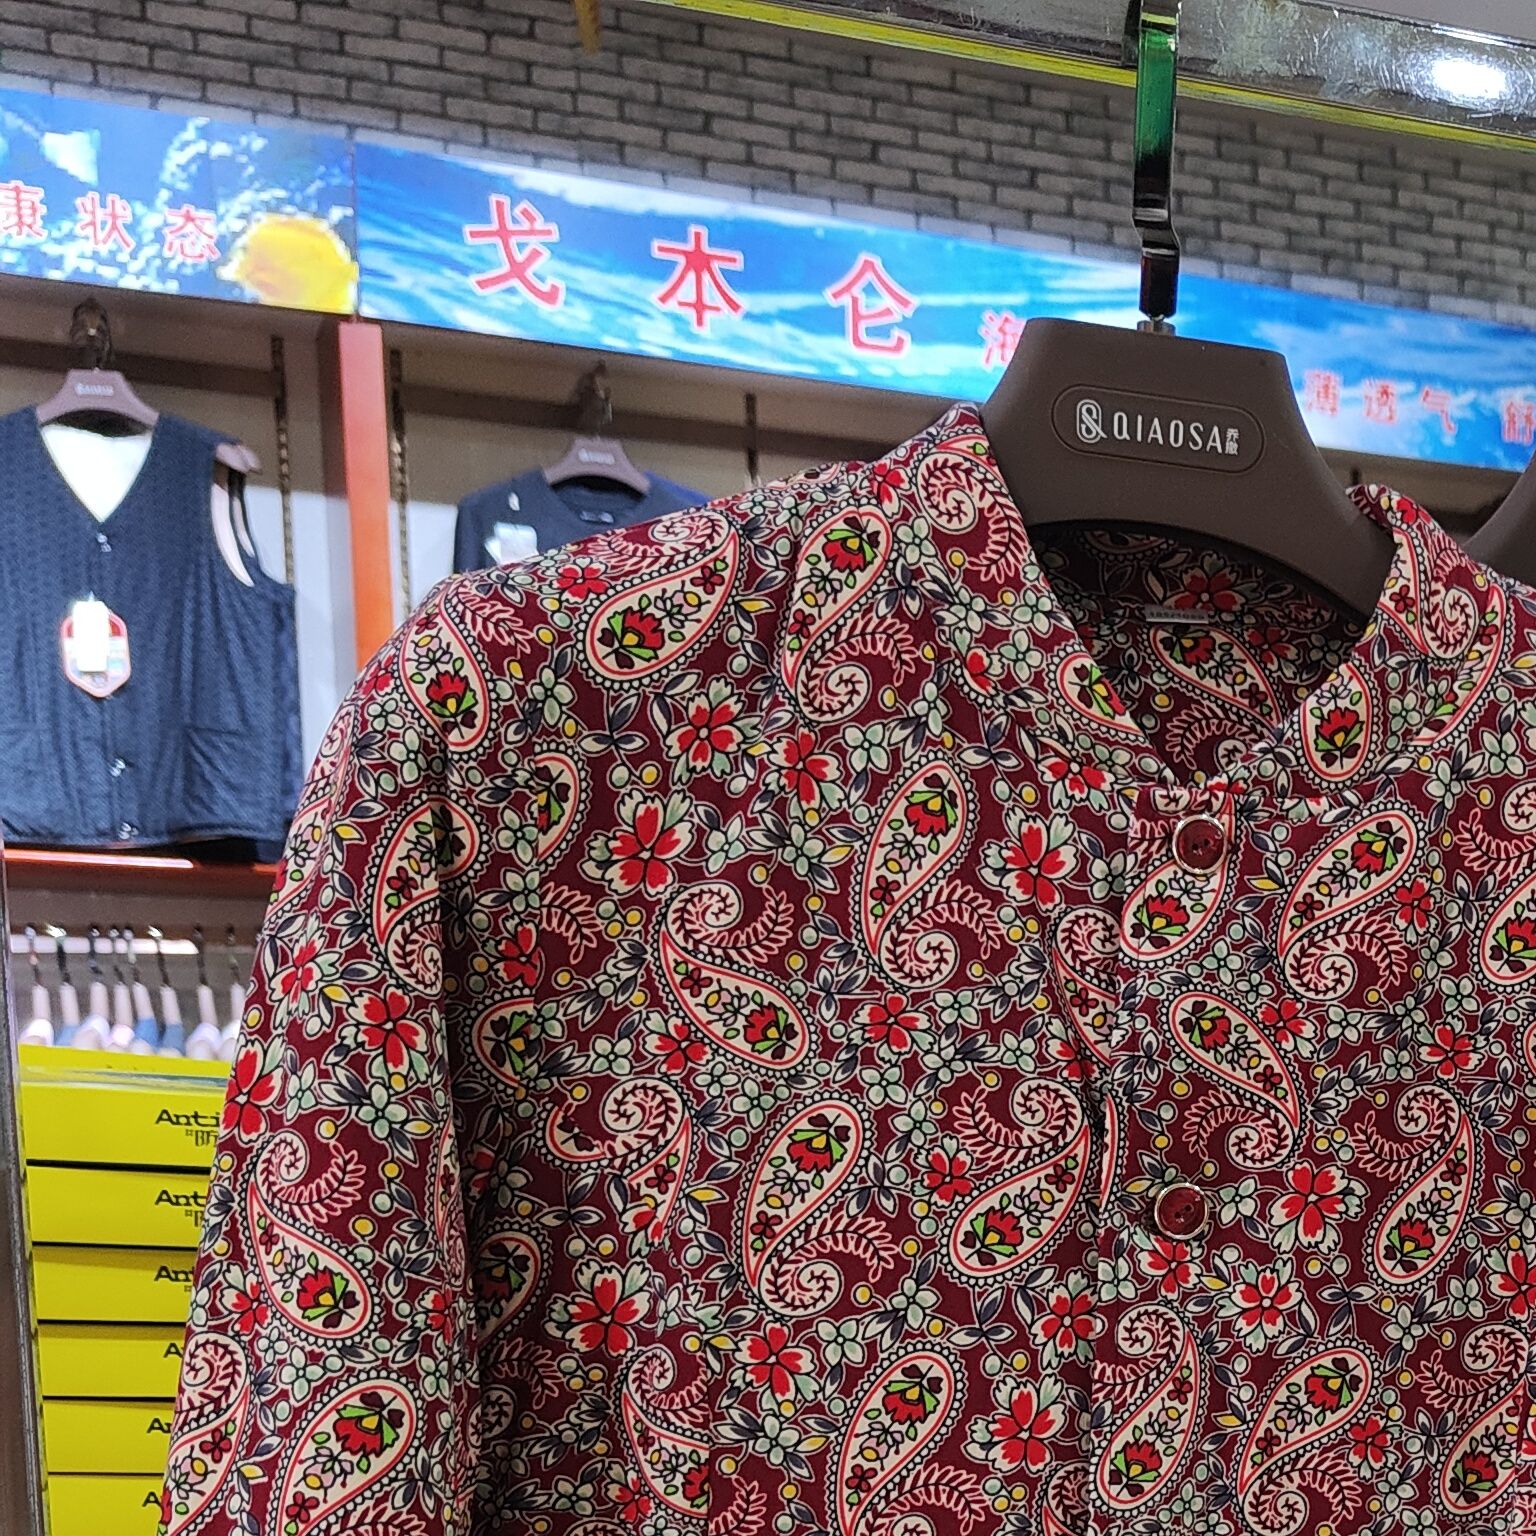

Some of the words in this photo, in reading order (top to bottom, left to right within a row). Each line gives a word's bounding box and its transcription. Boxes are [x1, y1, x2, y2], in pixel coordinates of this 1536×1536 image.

[463, 193, 919, 357] 戈本仑
[1113, 411, 1223, 454] QIAOSA
